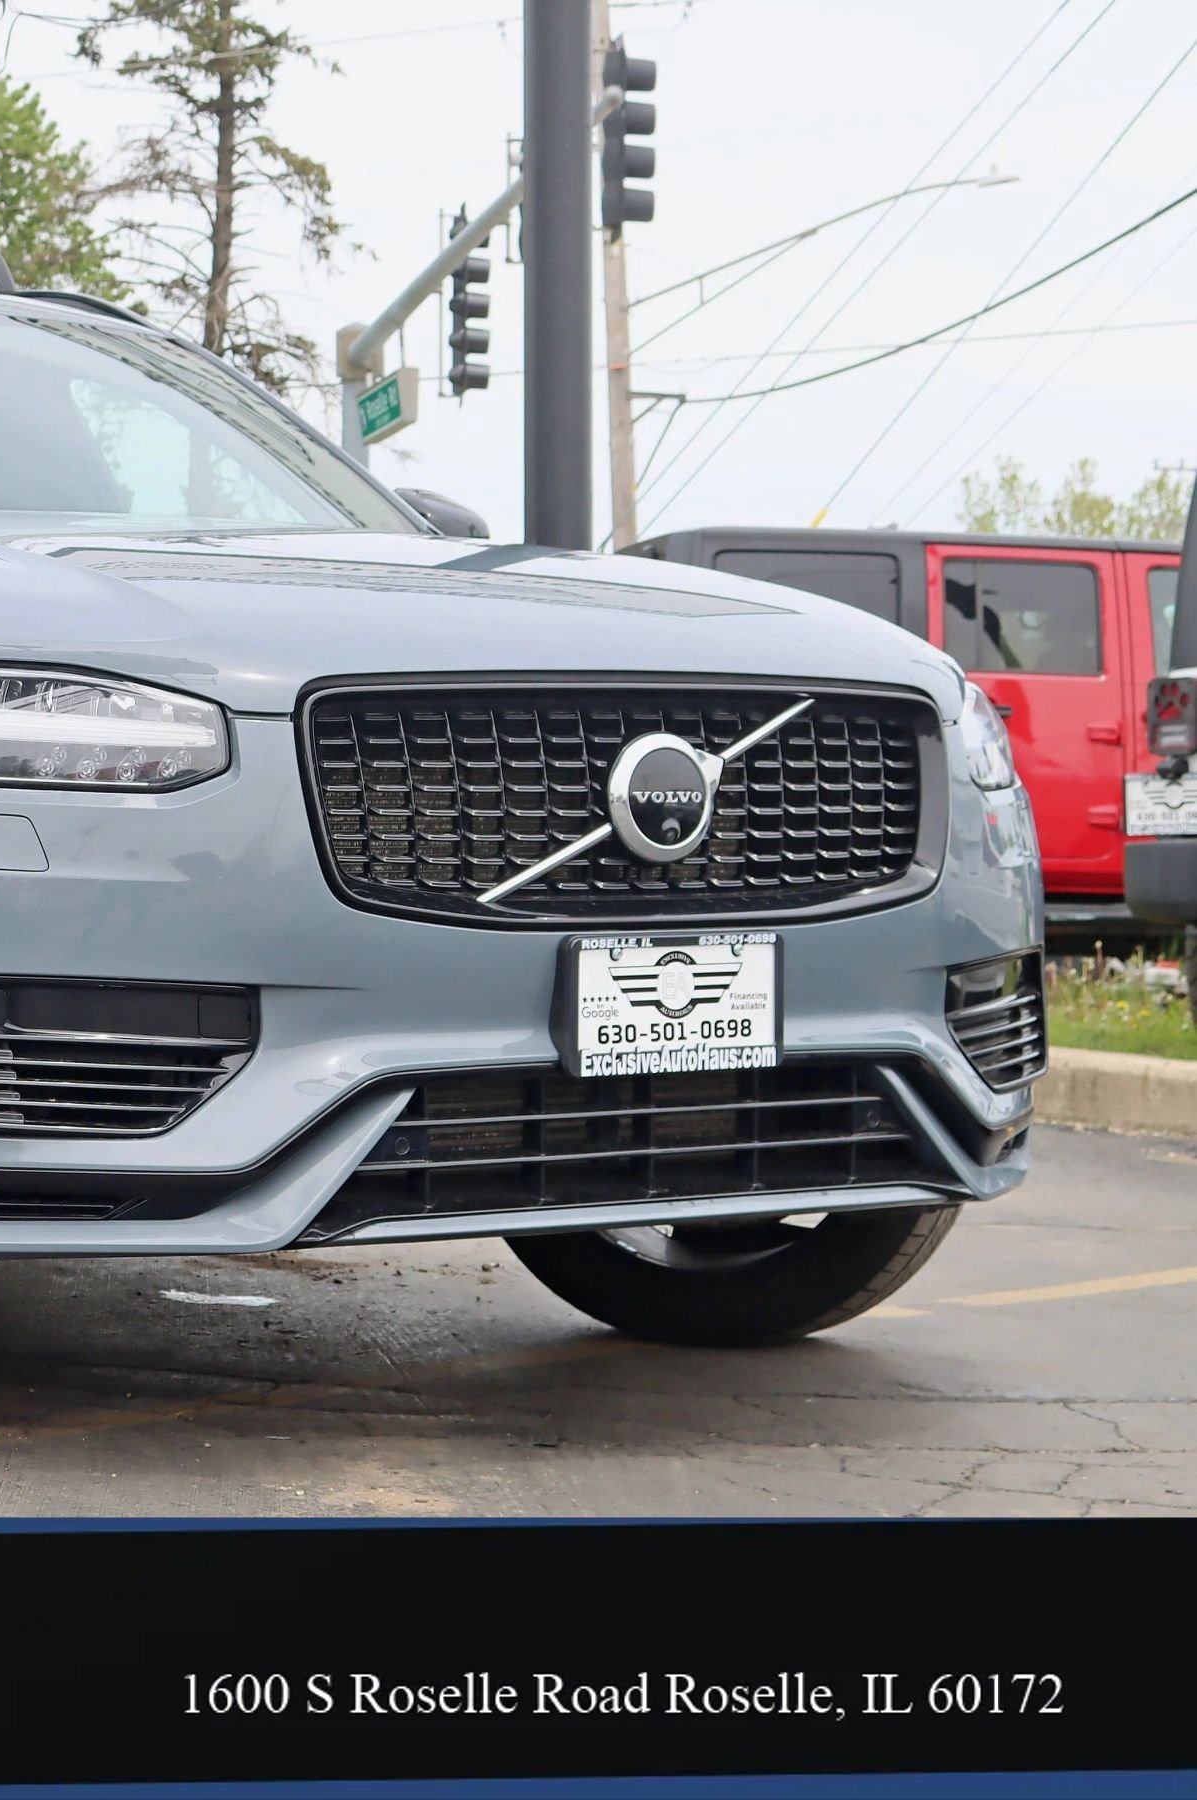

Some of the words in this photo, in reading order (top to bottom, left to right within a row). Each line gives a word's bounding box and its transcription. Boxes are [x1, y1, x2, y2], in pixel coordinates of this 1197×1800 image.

[632, 791, 703, 804] VOLVO
[641, 937, 654, 948] IL
[698, 932, 777, 946] 630-501-0698
[730, 992, 768, 1002] Financing
[581, 1005, 619, 1020] Google
[597, 1018, 752, 1044] 630-501-0698
[580, 1045, 777, 1078] ExclusiveAutoHaus.com
